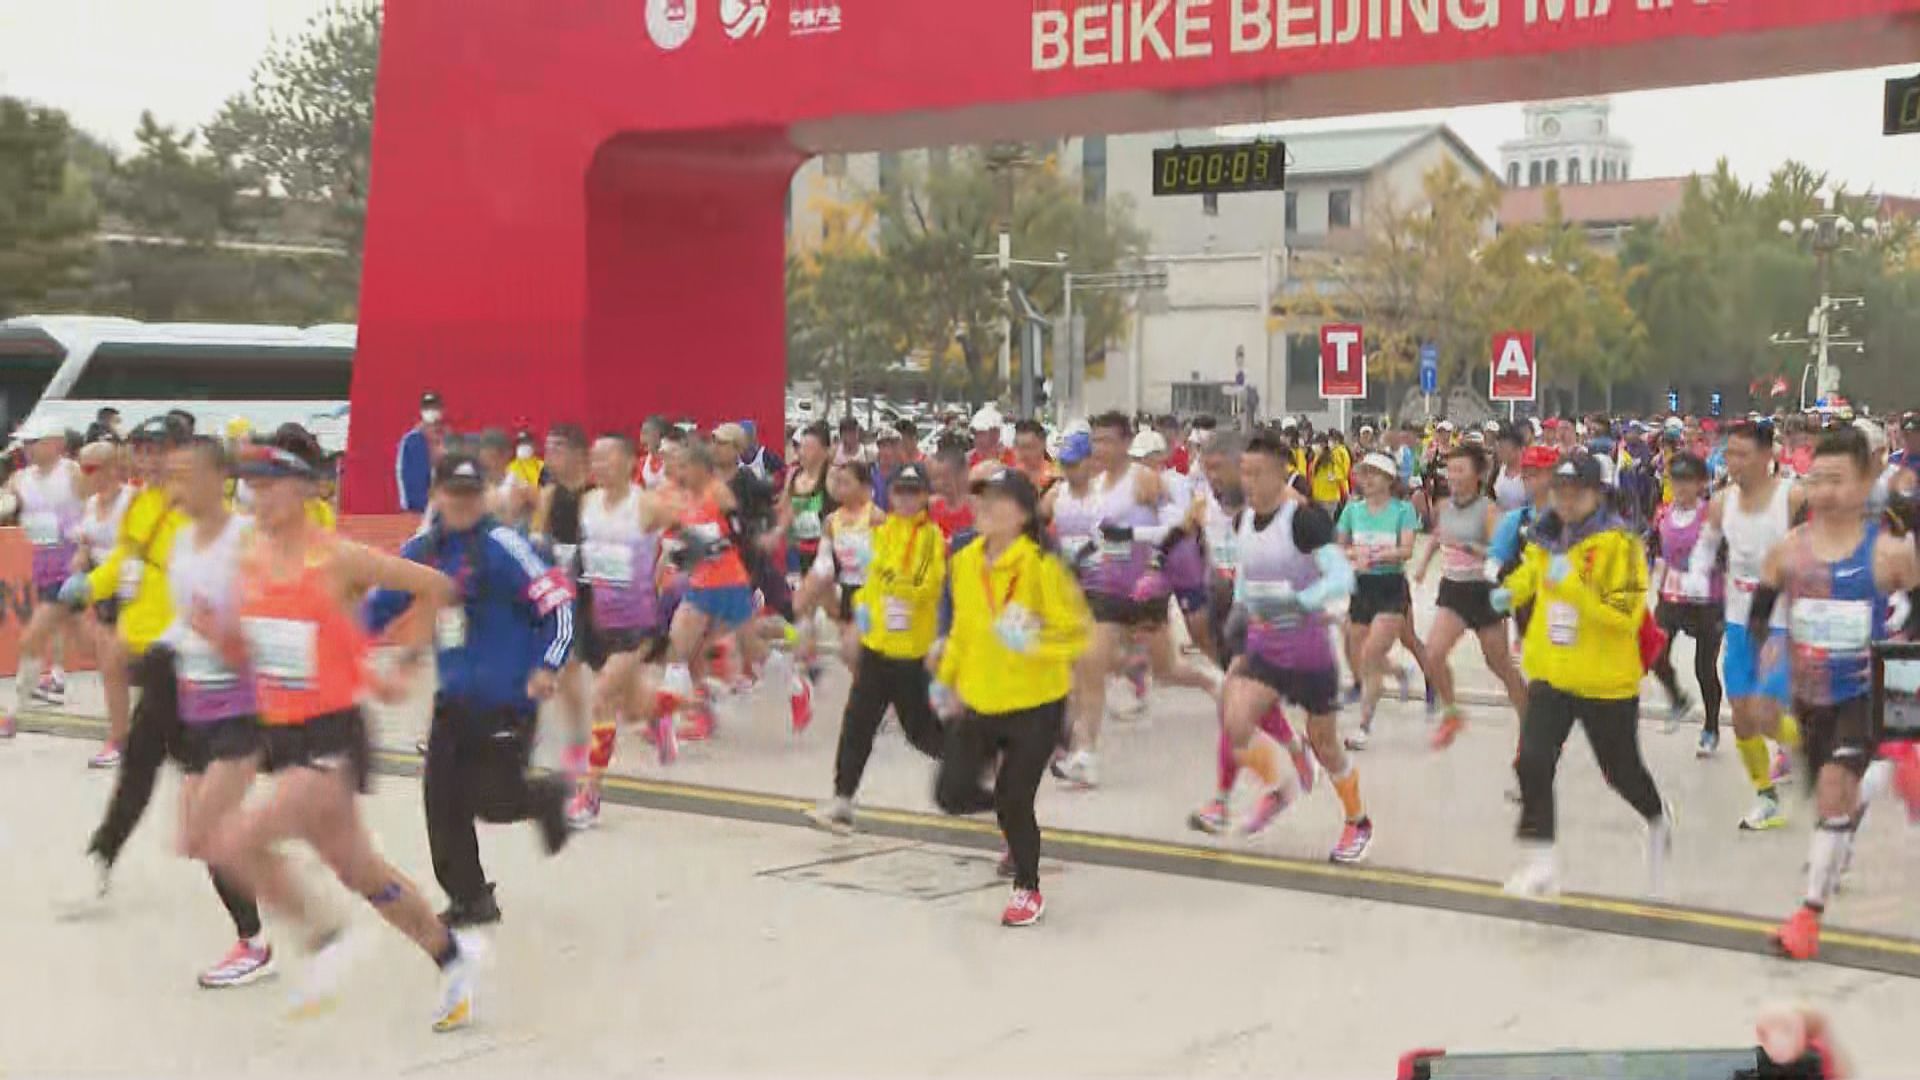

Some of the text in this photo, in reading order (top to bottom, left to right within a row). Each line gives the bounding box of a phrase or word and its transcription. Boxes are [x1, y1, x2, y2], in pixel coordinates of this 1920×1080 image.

[1032, 0, 1213, 71] BEIKE
[1326, 332, 1358, 371] T
[1496, 339, 1530, 376] A
